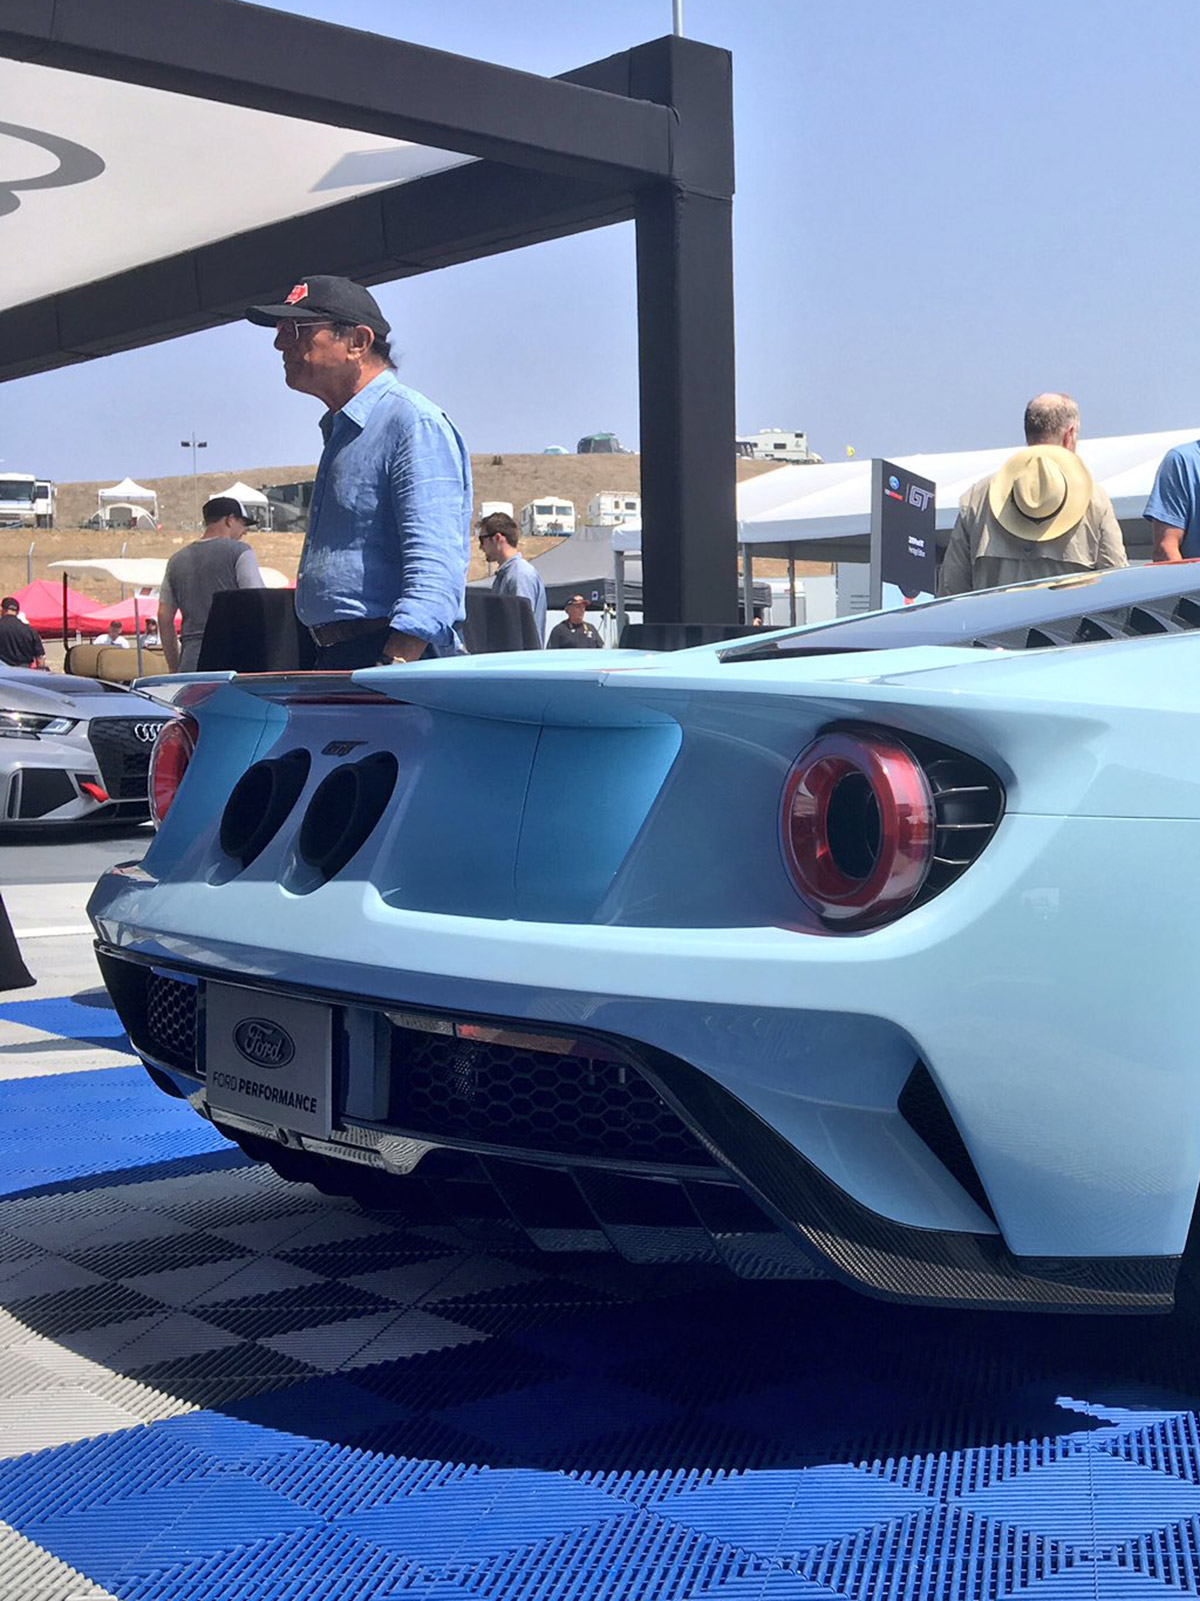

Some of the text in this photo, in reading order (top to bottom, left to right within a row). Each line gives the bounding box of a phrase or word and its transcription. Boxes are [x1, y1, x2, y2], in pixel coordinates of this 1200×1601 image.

[909, 486, 934, 511] GT
[242, 1022, 285, 1061] Ford
[212, 1071, 318, 1114] FORD PERFORMANCE
